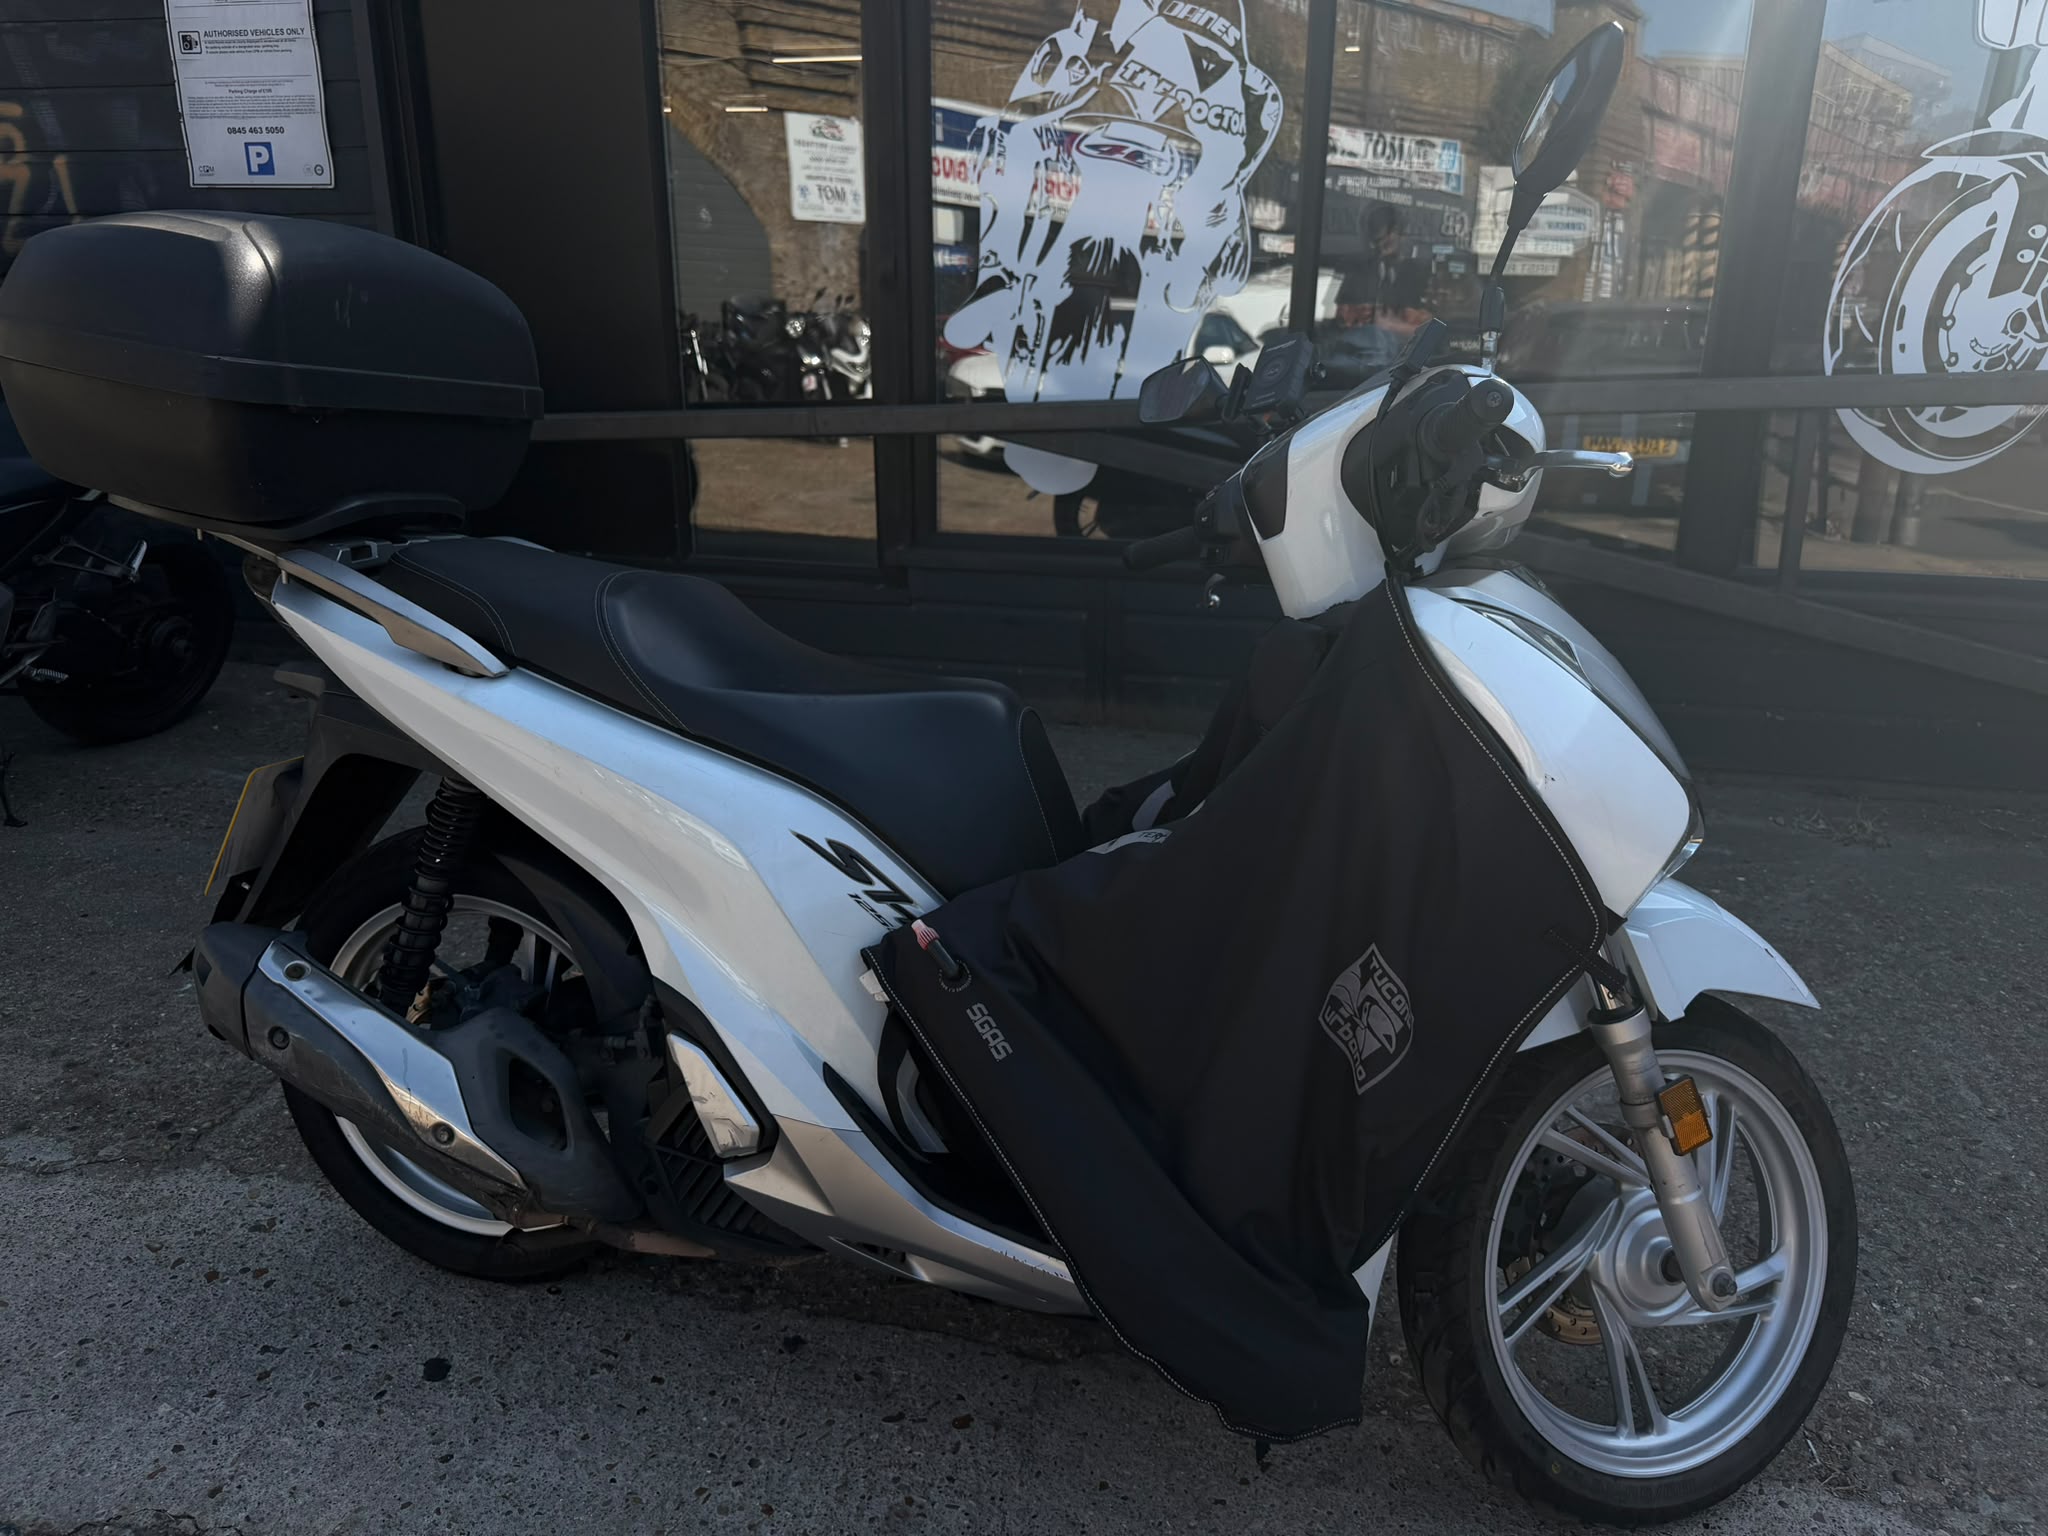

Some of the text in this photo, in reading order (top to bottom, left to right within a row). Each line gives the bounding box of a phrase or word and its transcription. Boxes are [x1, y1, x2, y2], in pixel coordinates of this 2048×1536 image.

[203, 30, 249, 38] AUTHORISED
[250, 29, 285, 37] VEHICLES
[227, 126, 285, 135] 0845 463 5050
